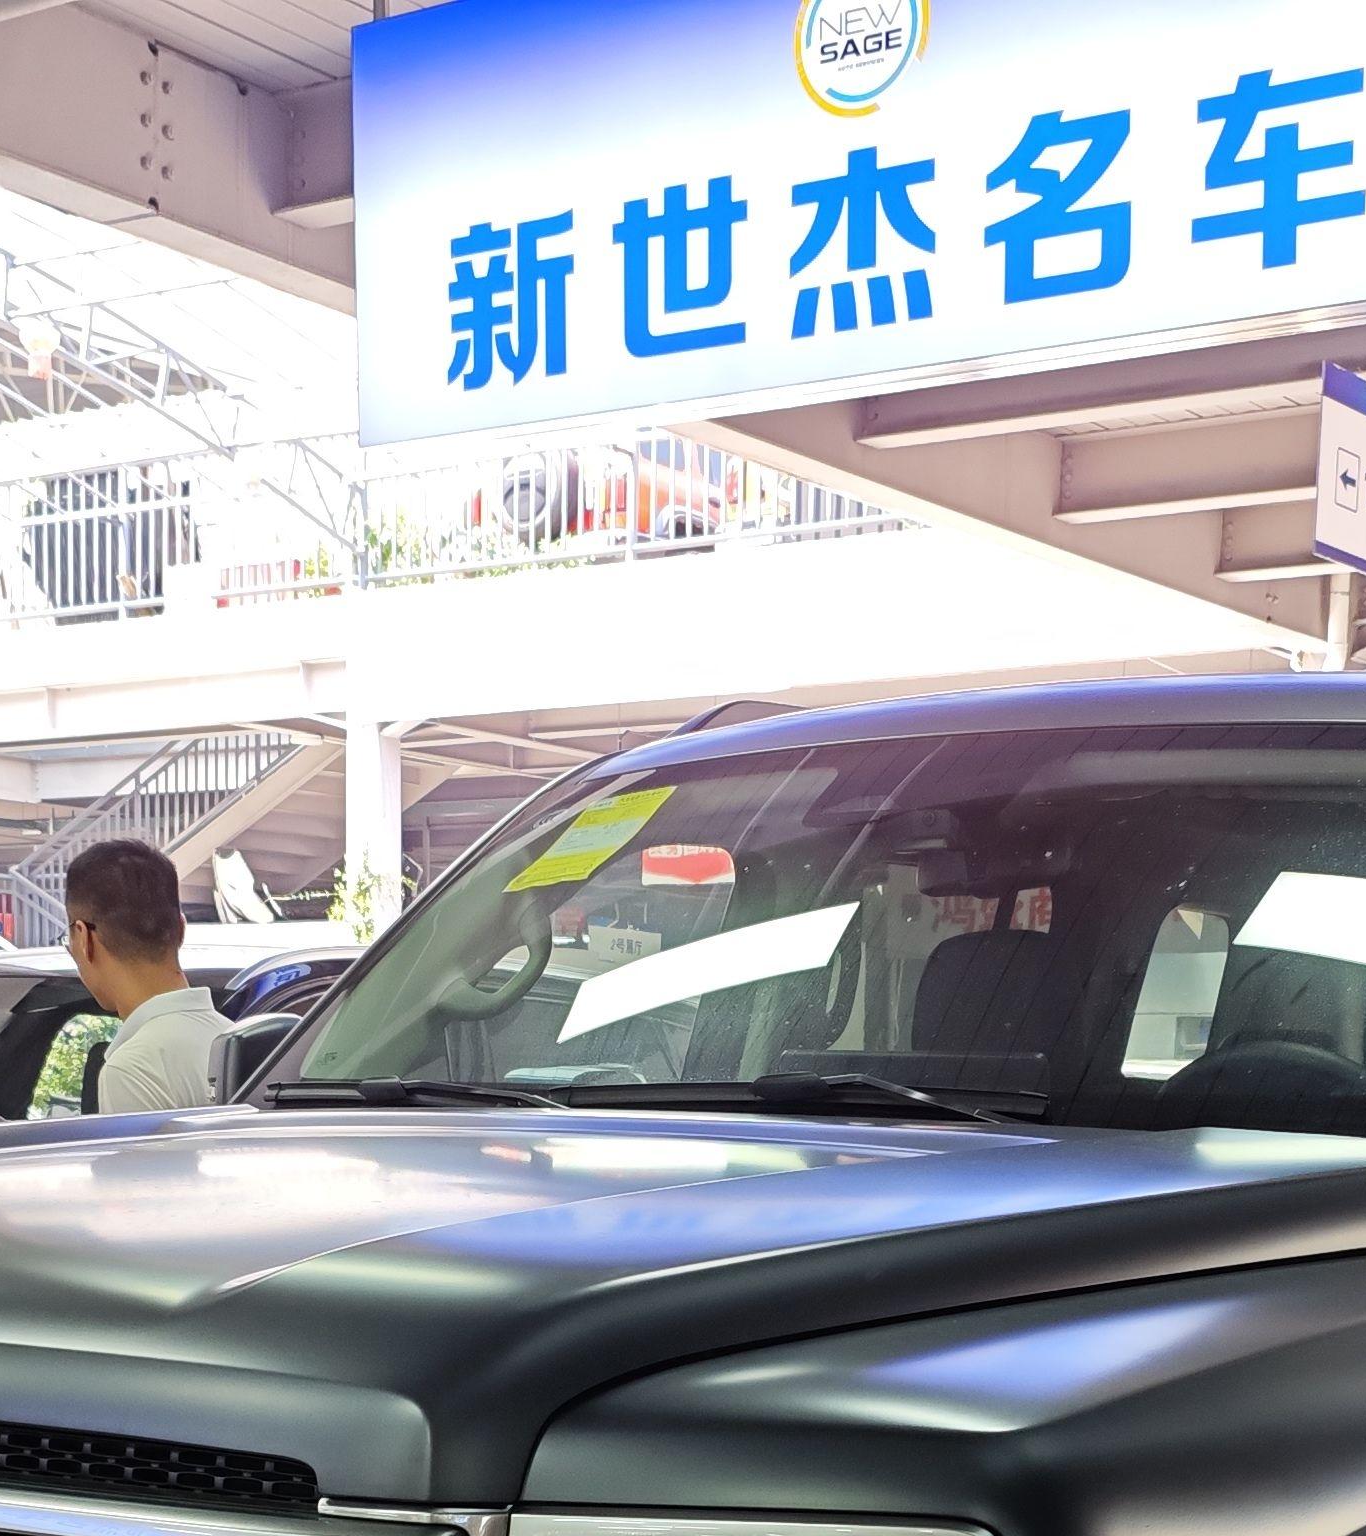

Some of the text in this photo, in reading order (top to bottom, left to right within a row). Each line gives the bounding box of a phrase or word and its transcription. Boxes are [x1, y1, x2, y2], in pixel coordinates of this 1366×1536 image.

[820, 0, 902, 41] NEW
[820, 28, 903, 64] SAGE
[447, 68, 1366, 393] 新世杰名车
